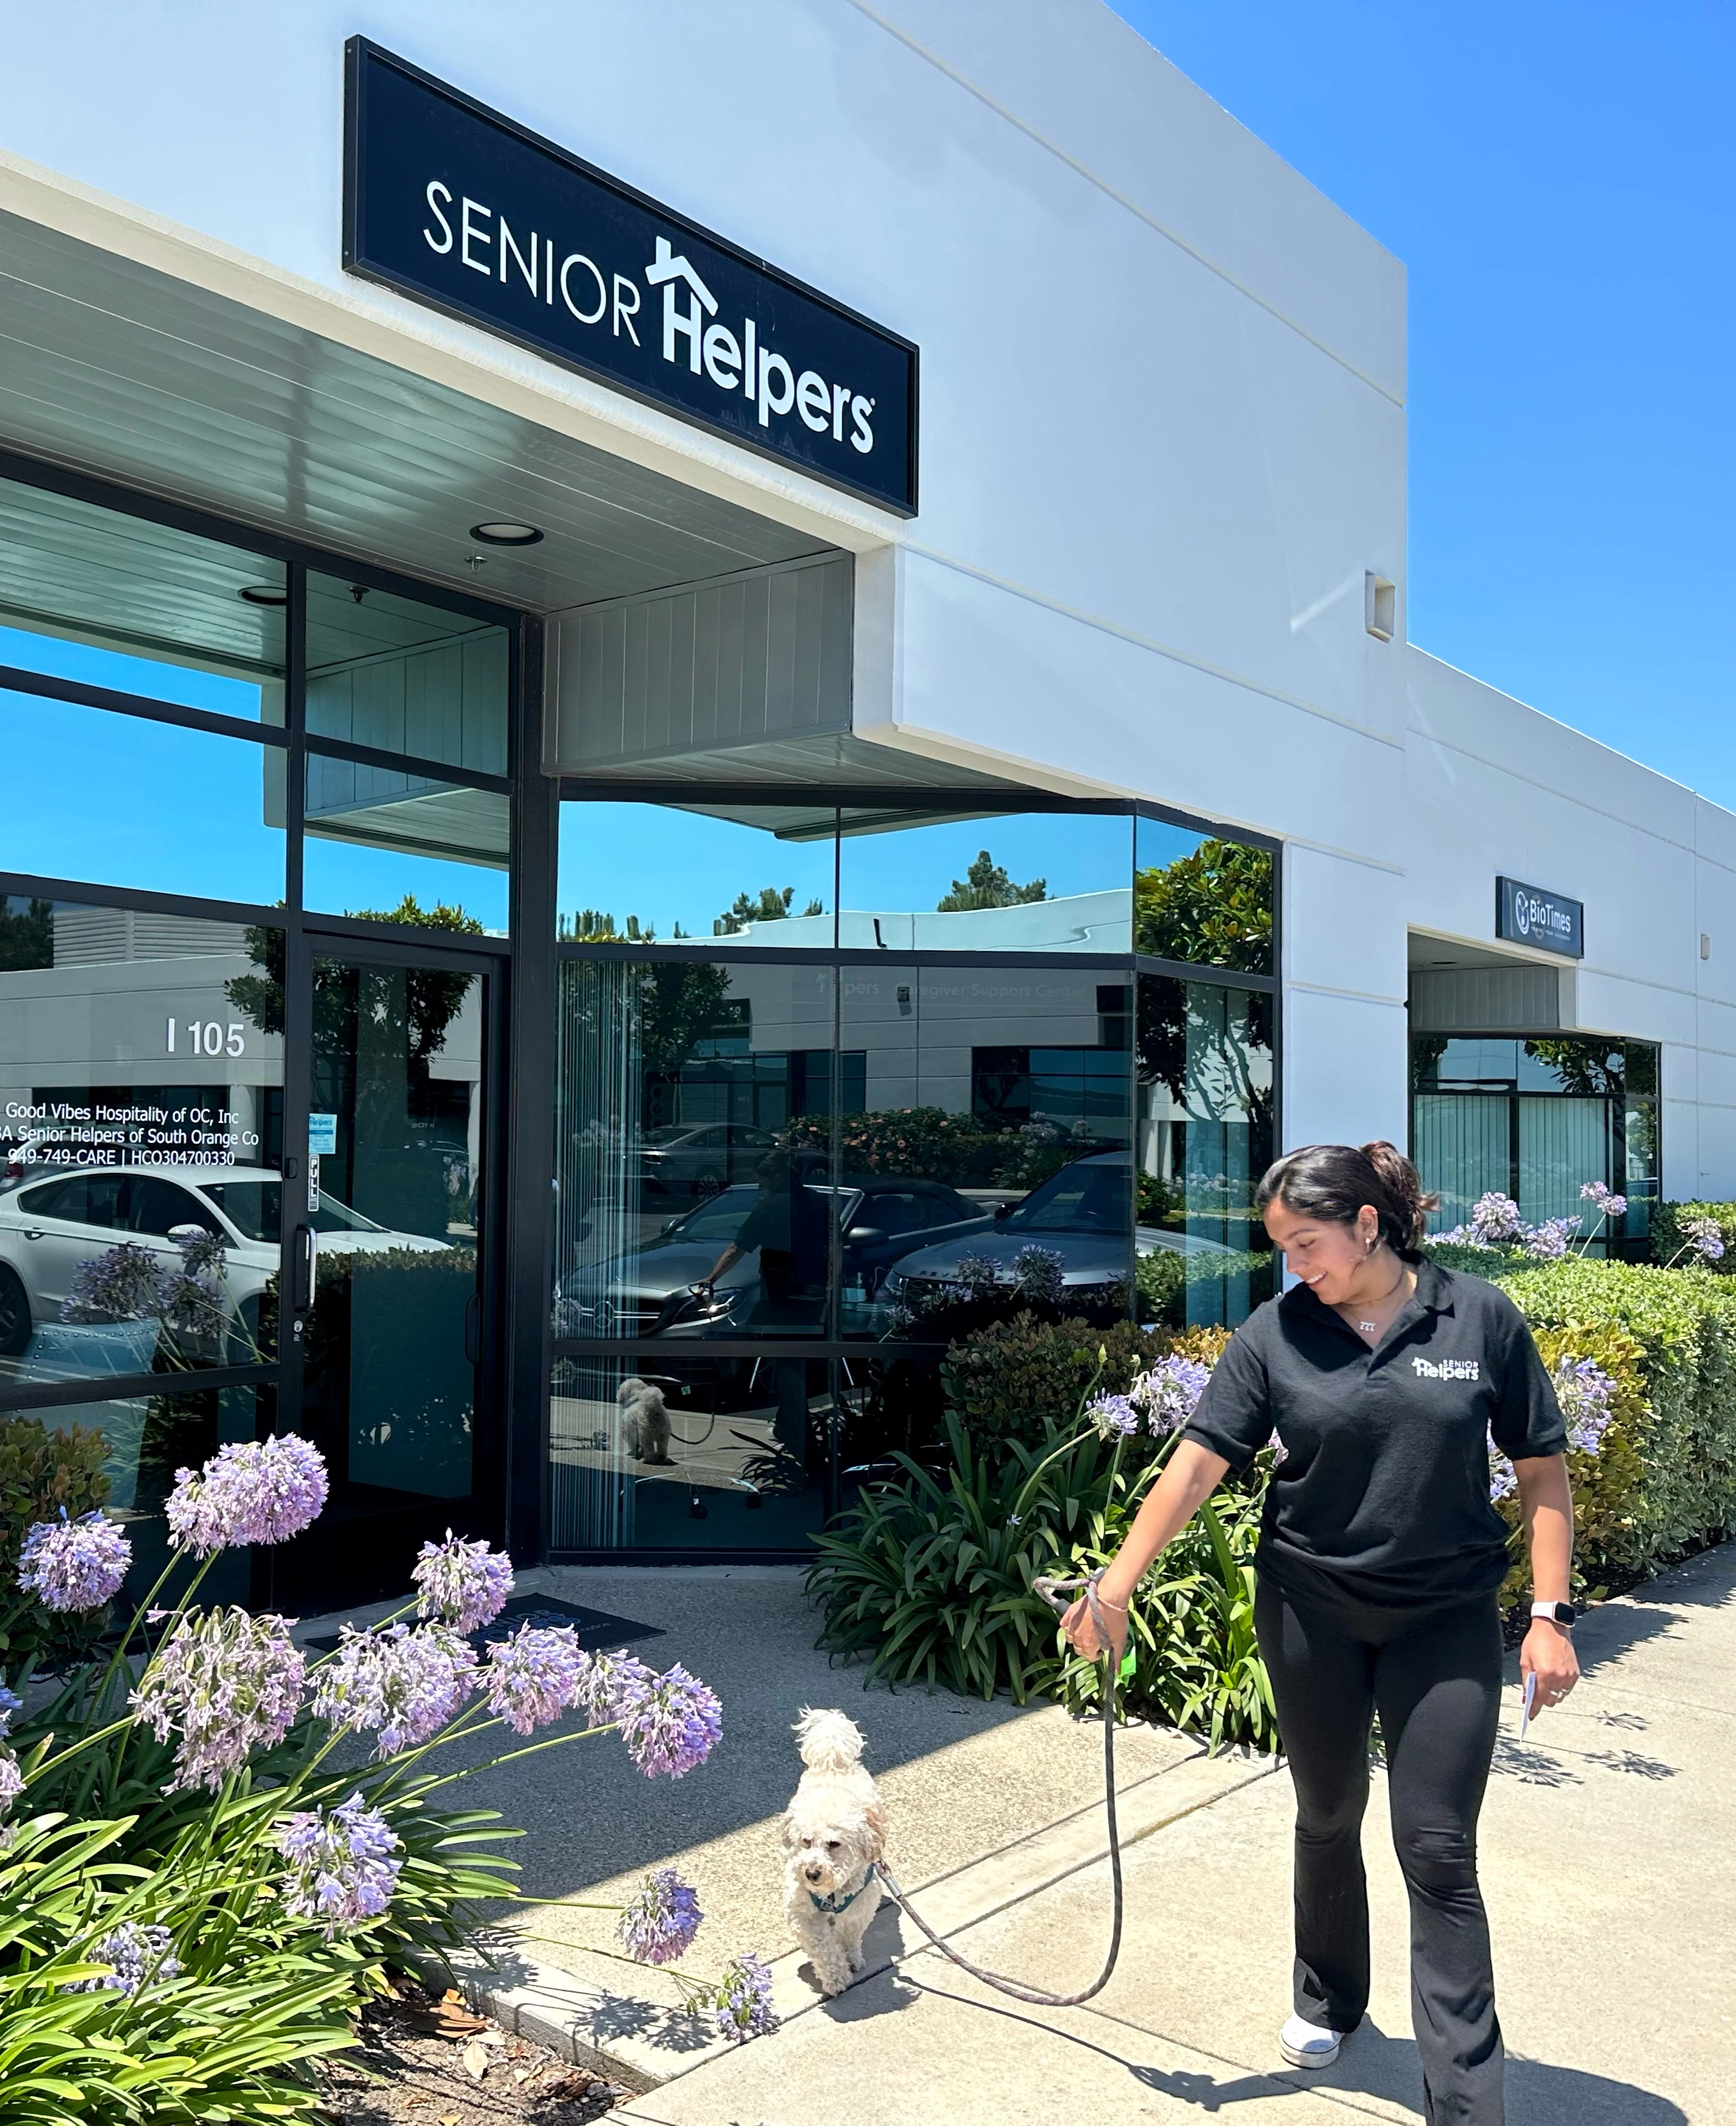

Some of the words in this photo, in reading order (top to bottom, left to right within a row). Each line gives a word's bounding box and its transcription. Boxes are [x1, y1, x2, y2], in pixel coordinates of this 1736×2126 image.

[423, 180, 641, 347] SENIOR
[660, 271, 875, 454] Helpers
[1530, 899, 1571, 933] BioTimes
[971, 983, 1031, 998] Support
[1035, 984, 1086, 997] Center
[188, 1021, 245, 1057] 105
[6, 1102, 46, 1119] Good
[51, 1103, 91, 1120] Vibes
[96, 1105, 168, 1125] Hospitality
[172, 1107, 187, 1123] of
[190, 1108, 214, 1126] OC,
[218, 1109, 239, 1124] Inc
[0, 1125, 13, 1141] A
[17, 1125, 66, 1142] Senior
[71, 1126, 125, 1146] Helpers
[129, 1128, 145, 1144] of
[147, 1129, 187, 1144] South
[191, 1129, 238, 1148] Orange
[242, 1131, 259, 1146] Co
[8, 1148, 116, 1165] 949-749-CARE
[131, 1150, 235, 1166] HCO304700330
[1415, 1360, 1479, 1381] Helpers
[1443, 1359, 1478, 1368] SENIOR
